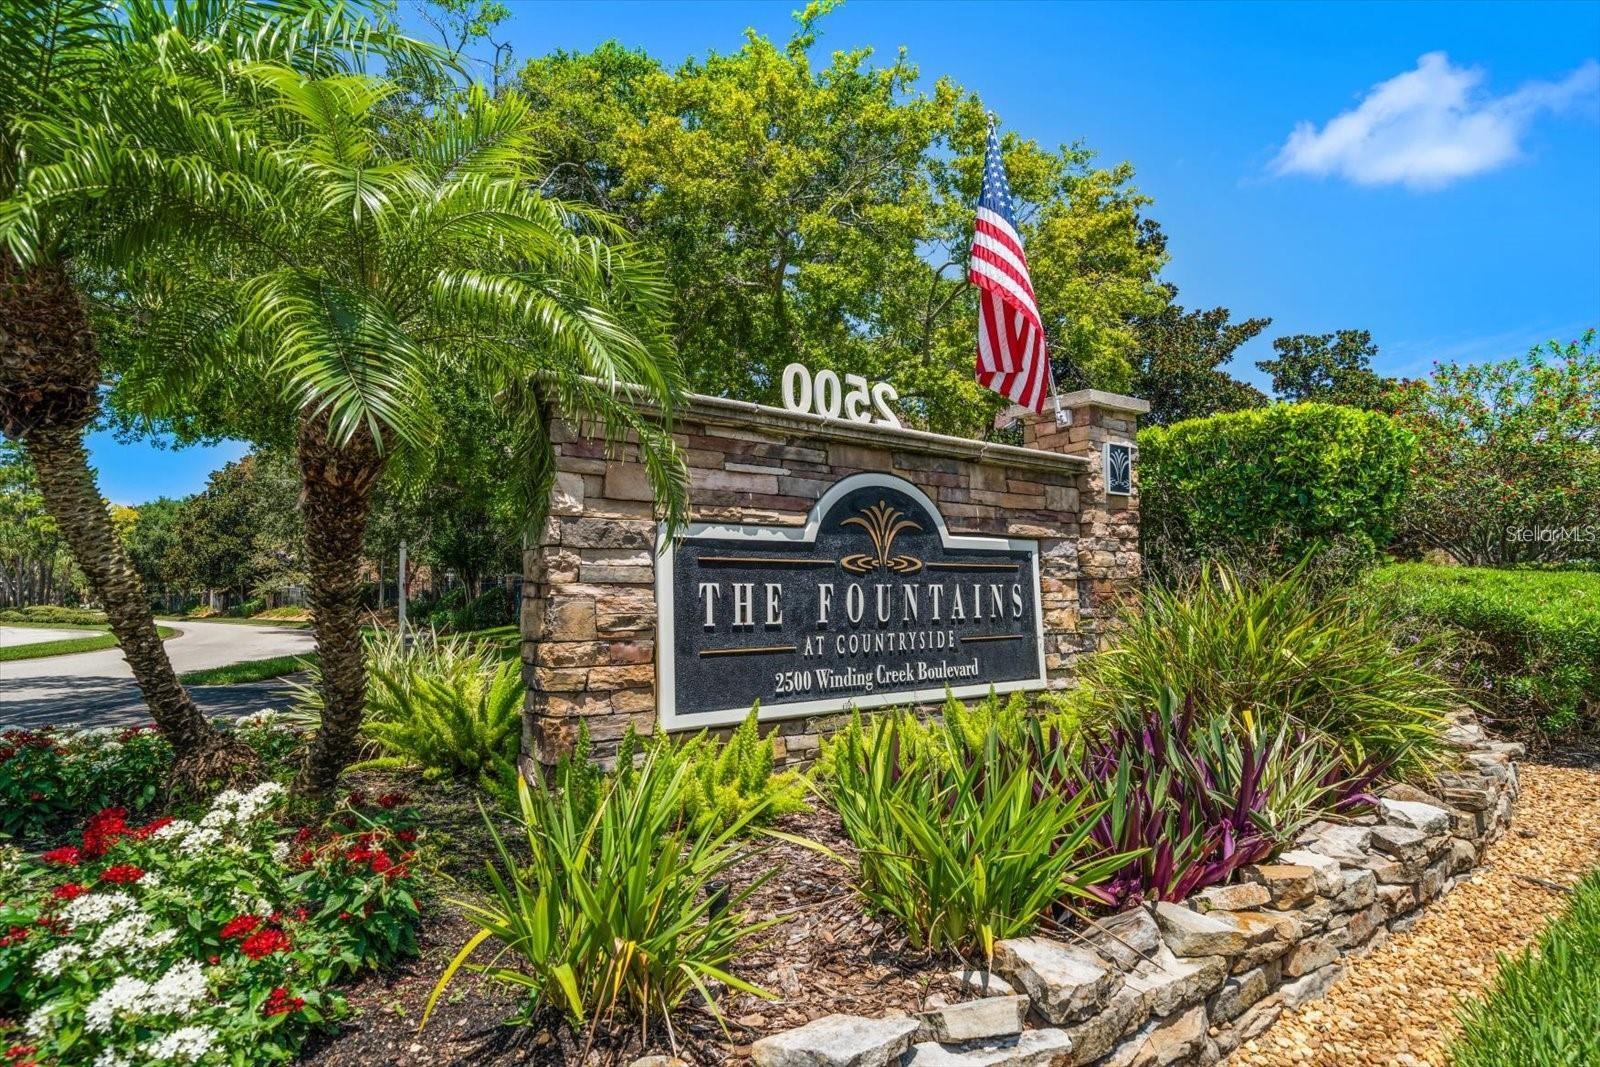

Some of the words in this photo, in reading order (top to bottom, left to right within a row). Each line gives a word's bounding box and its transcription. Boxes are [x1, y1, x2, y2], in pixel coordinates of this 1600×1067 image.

[699, 582, 784, 627] THE
[817, 582, 1024, 624] FOUNTAINS
[804, 635, 825, 656] AT
[836, 630, 956, 654] COUNTRYSIDE
[775, 670, 812, 693] 2500
[815, 667, 874, 691] Winding
[876, 662, 915, 685] Creek
[917, 657, 979, 681] Boulevard
